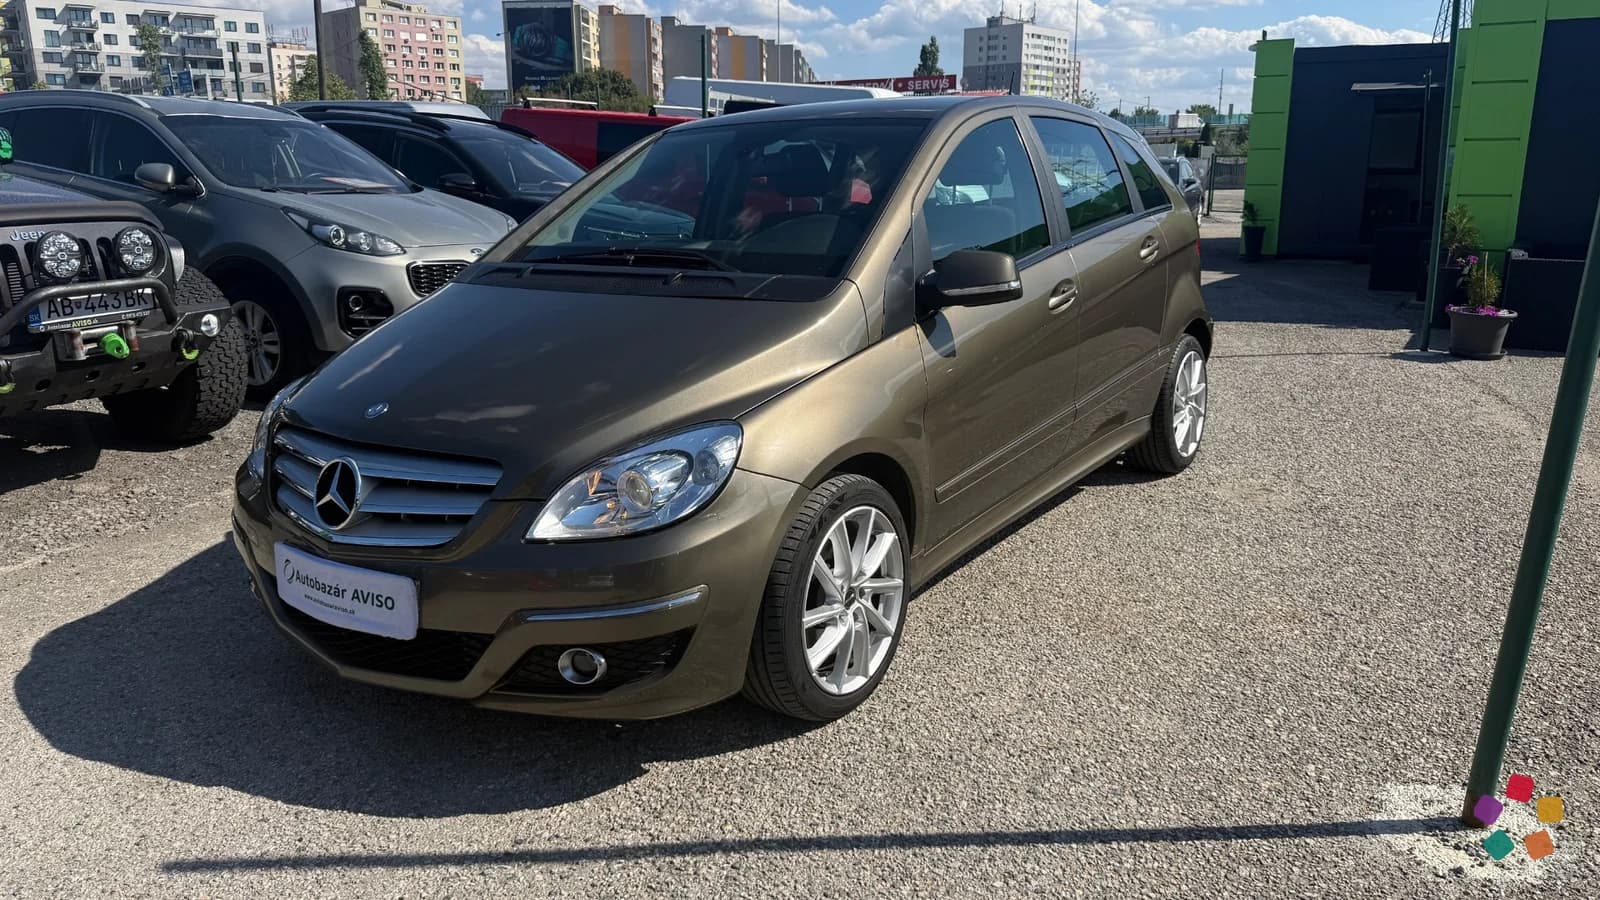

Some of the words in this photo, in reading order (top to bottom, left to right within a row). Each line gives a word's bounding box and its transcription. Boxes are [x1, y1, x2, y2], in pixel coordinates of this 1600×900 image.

[907, 79, 949, 91] SERVIS
[47, 298, 74, 318] AB
[295, 570, 347, 599] Autobazár
[351, 589, 395, 611] AVISO
